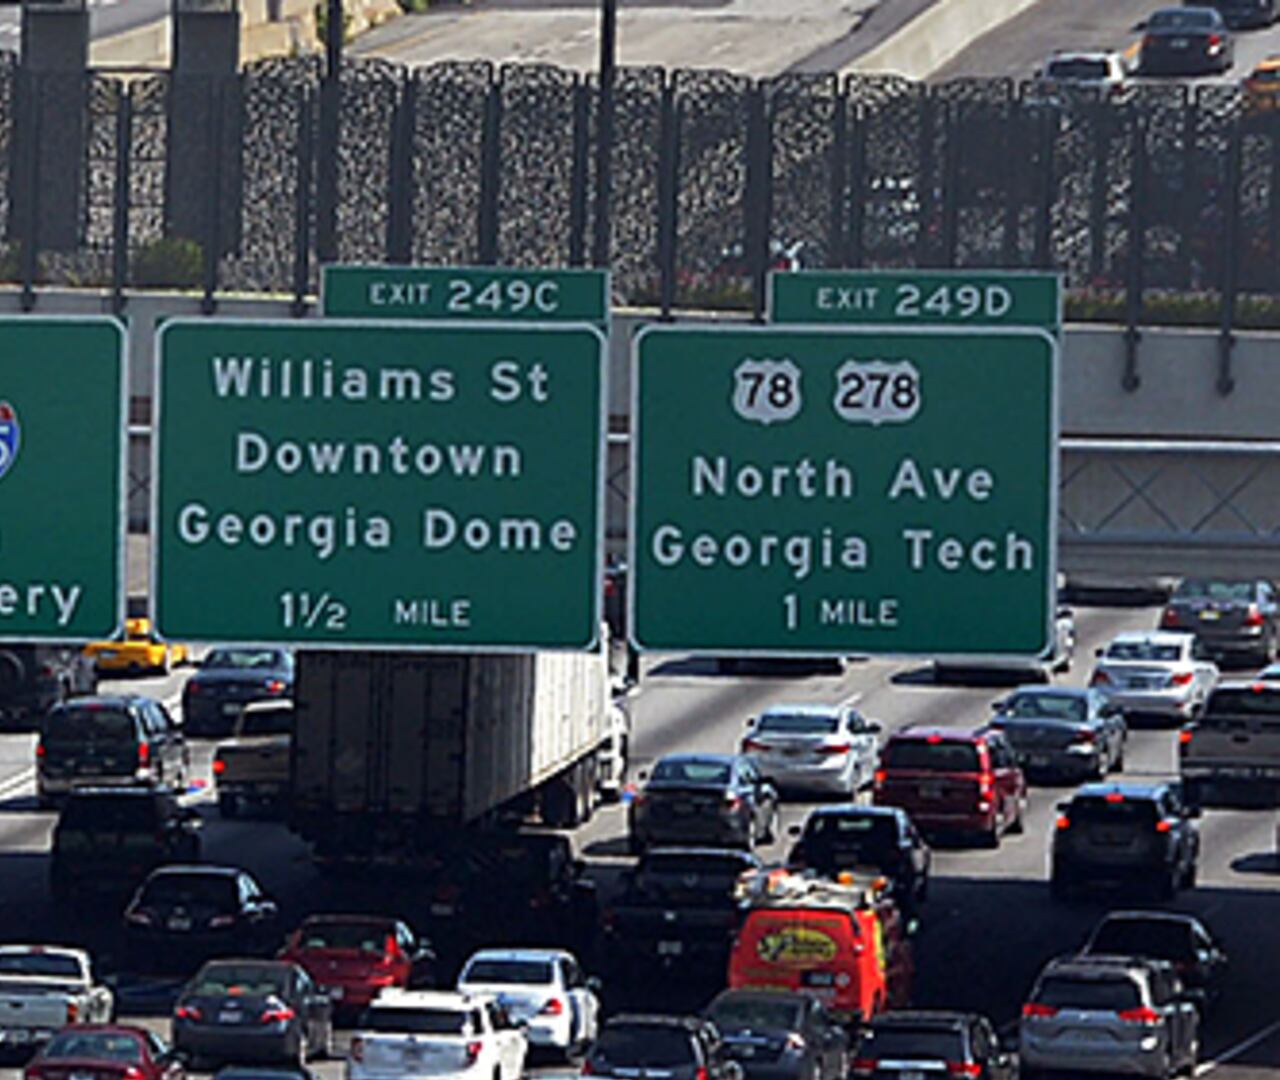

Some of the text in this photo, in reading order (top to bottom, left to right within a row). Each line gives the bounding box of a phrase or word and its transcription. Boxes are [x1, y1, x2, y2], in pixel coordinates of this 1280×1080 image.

[370, 280, 560, 313] EXIT 249C
[817, 284, 1012, 316] EXIT 249D
[213, 357, 549, 402] Williams St
[741, 372, 917, 410] 78 278
[237, 434, 522, 477] Downtown
[692, 457, 994, 500] North Ave
[178, 504, 577, 559] Georgia Dome
[652, 526, 1034, 579] Georgia Tech
[394, 601, 471, 626] MILE
[783, 594, 899, 631] 1 MILE
